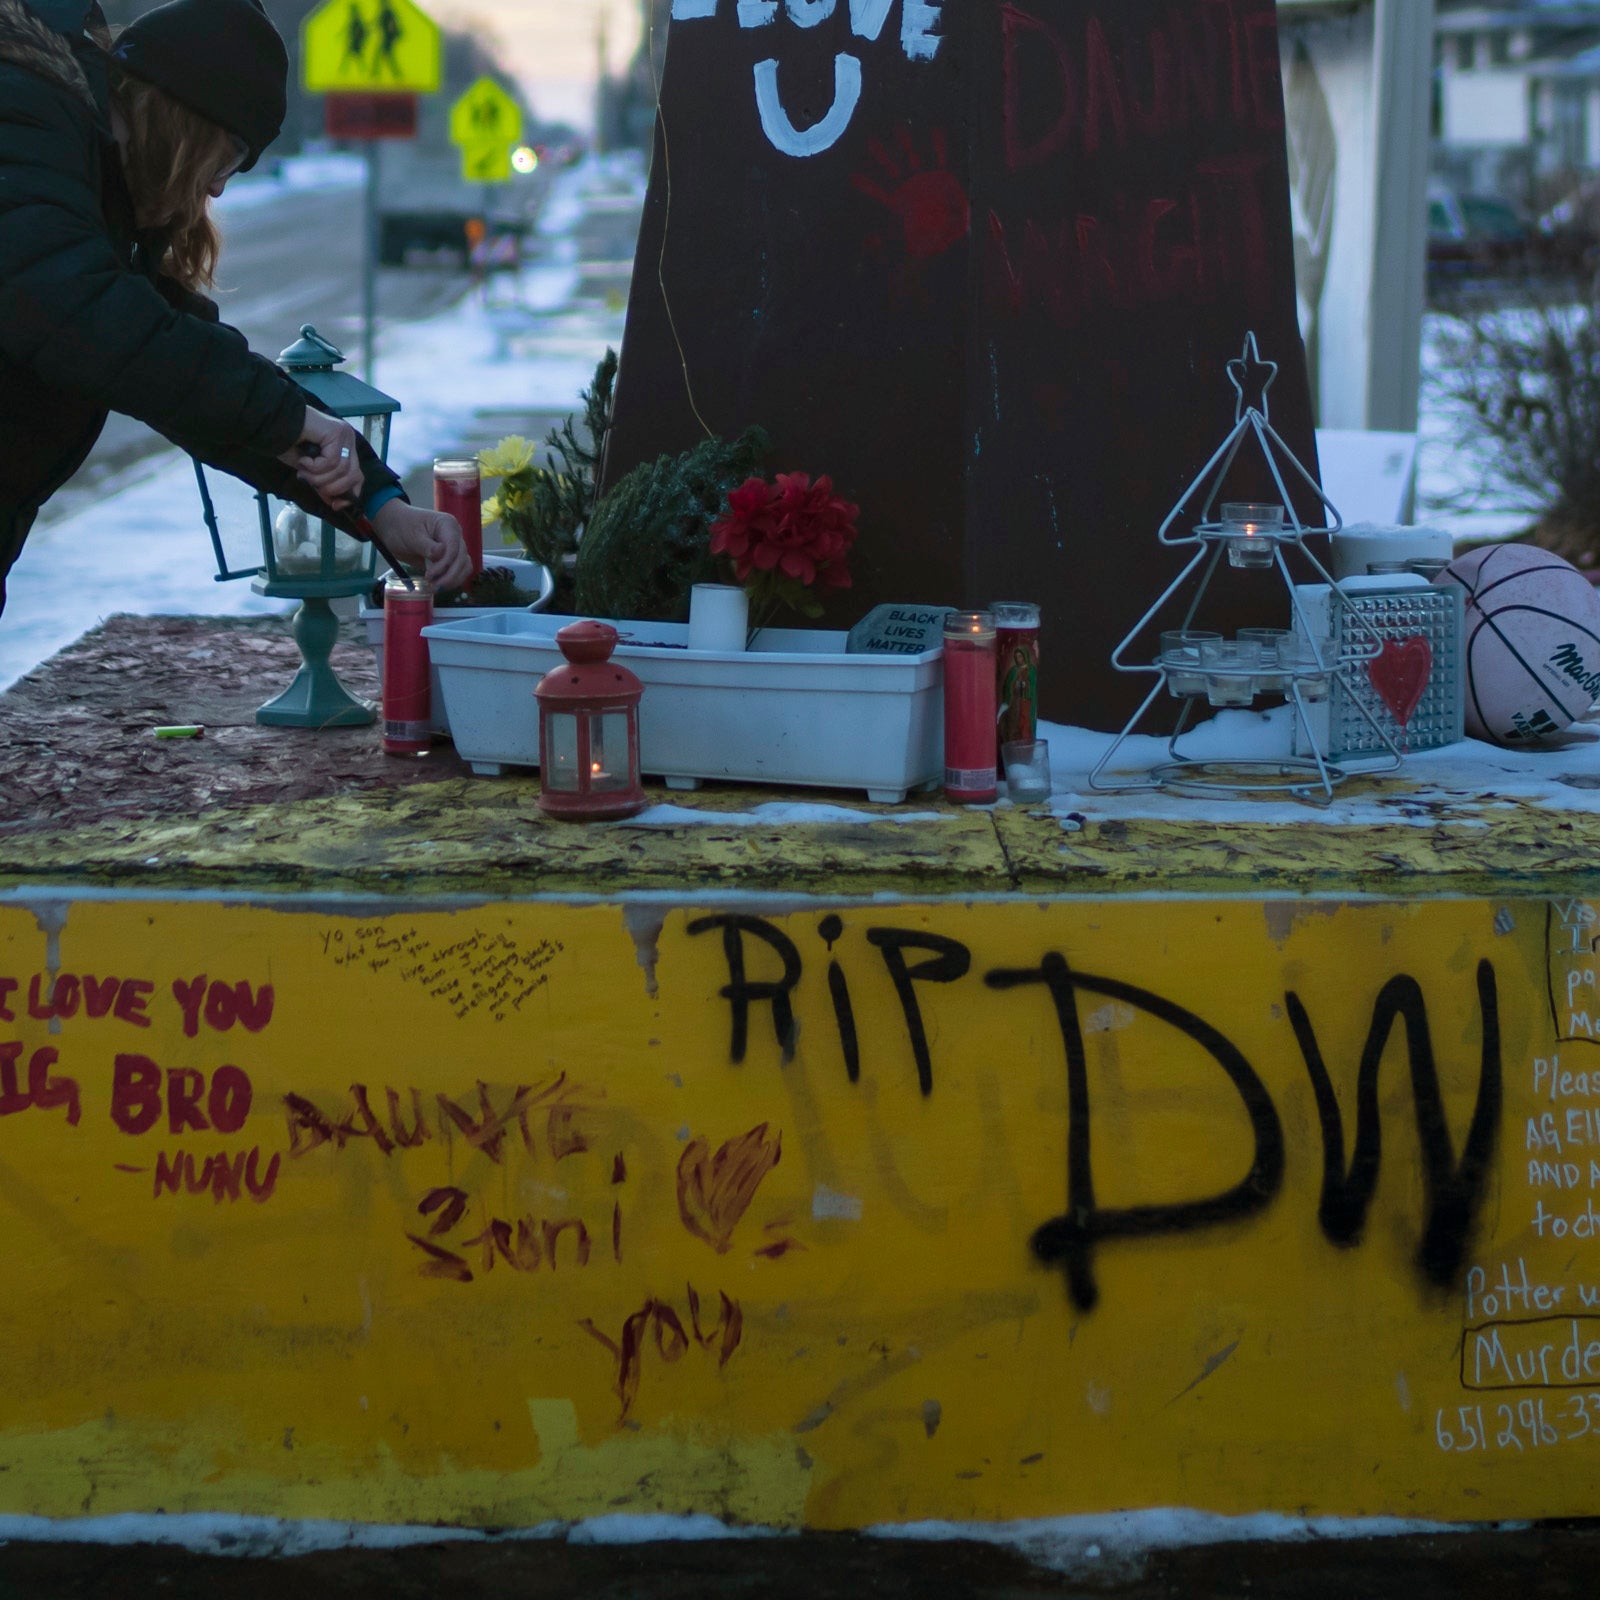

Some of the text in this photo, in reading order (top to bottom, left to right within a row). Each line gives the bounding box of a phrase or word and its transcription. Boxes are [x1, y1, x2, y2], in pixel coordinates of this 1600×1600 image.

[754, 52, 863, 158] U
[884, 625, 926, 639] LIVES
[888, 610, 938, 624] BLACK
[27, 973, 155, 1028] LOVE
[172, 973, 275, 1038] YOU
[110, 1053, 253, 1135] BRO
[982, 948, 1504, 1316] DW
[1526, 1113, 1562, 1154] AG
[1527, 1159, 1580, 1189] AND
[1531, 1199, 1569, 1239] to
[1466, 1256, 1565, 1319] Potter
[1435, 1403, 1486, 1452] 651
